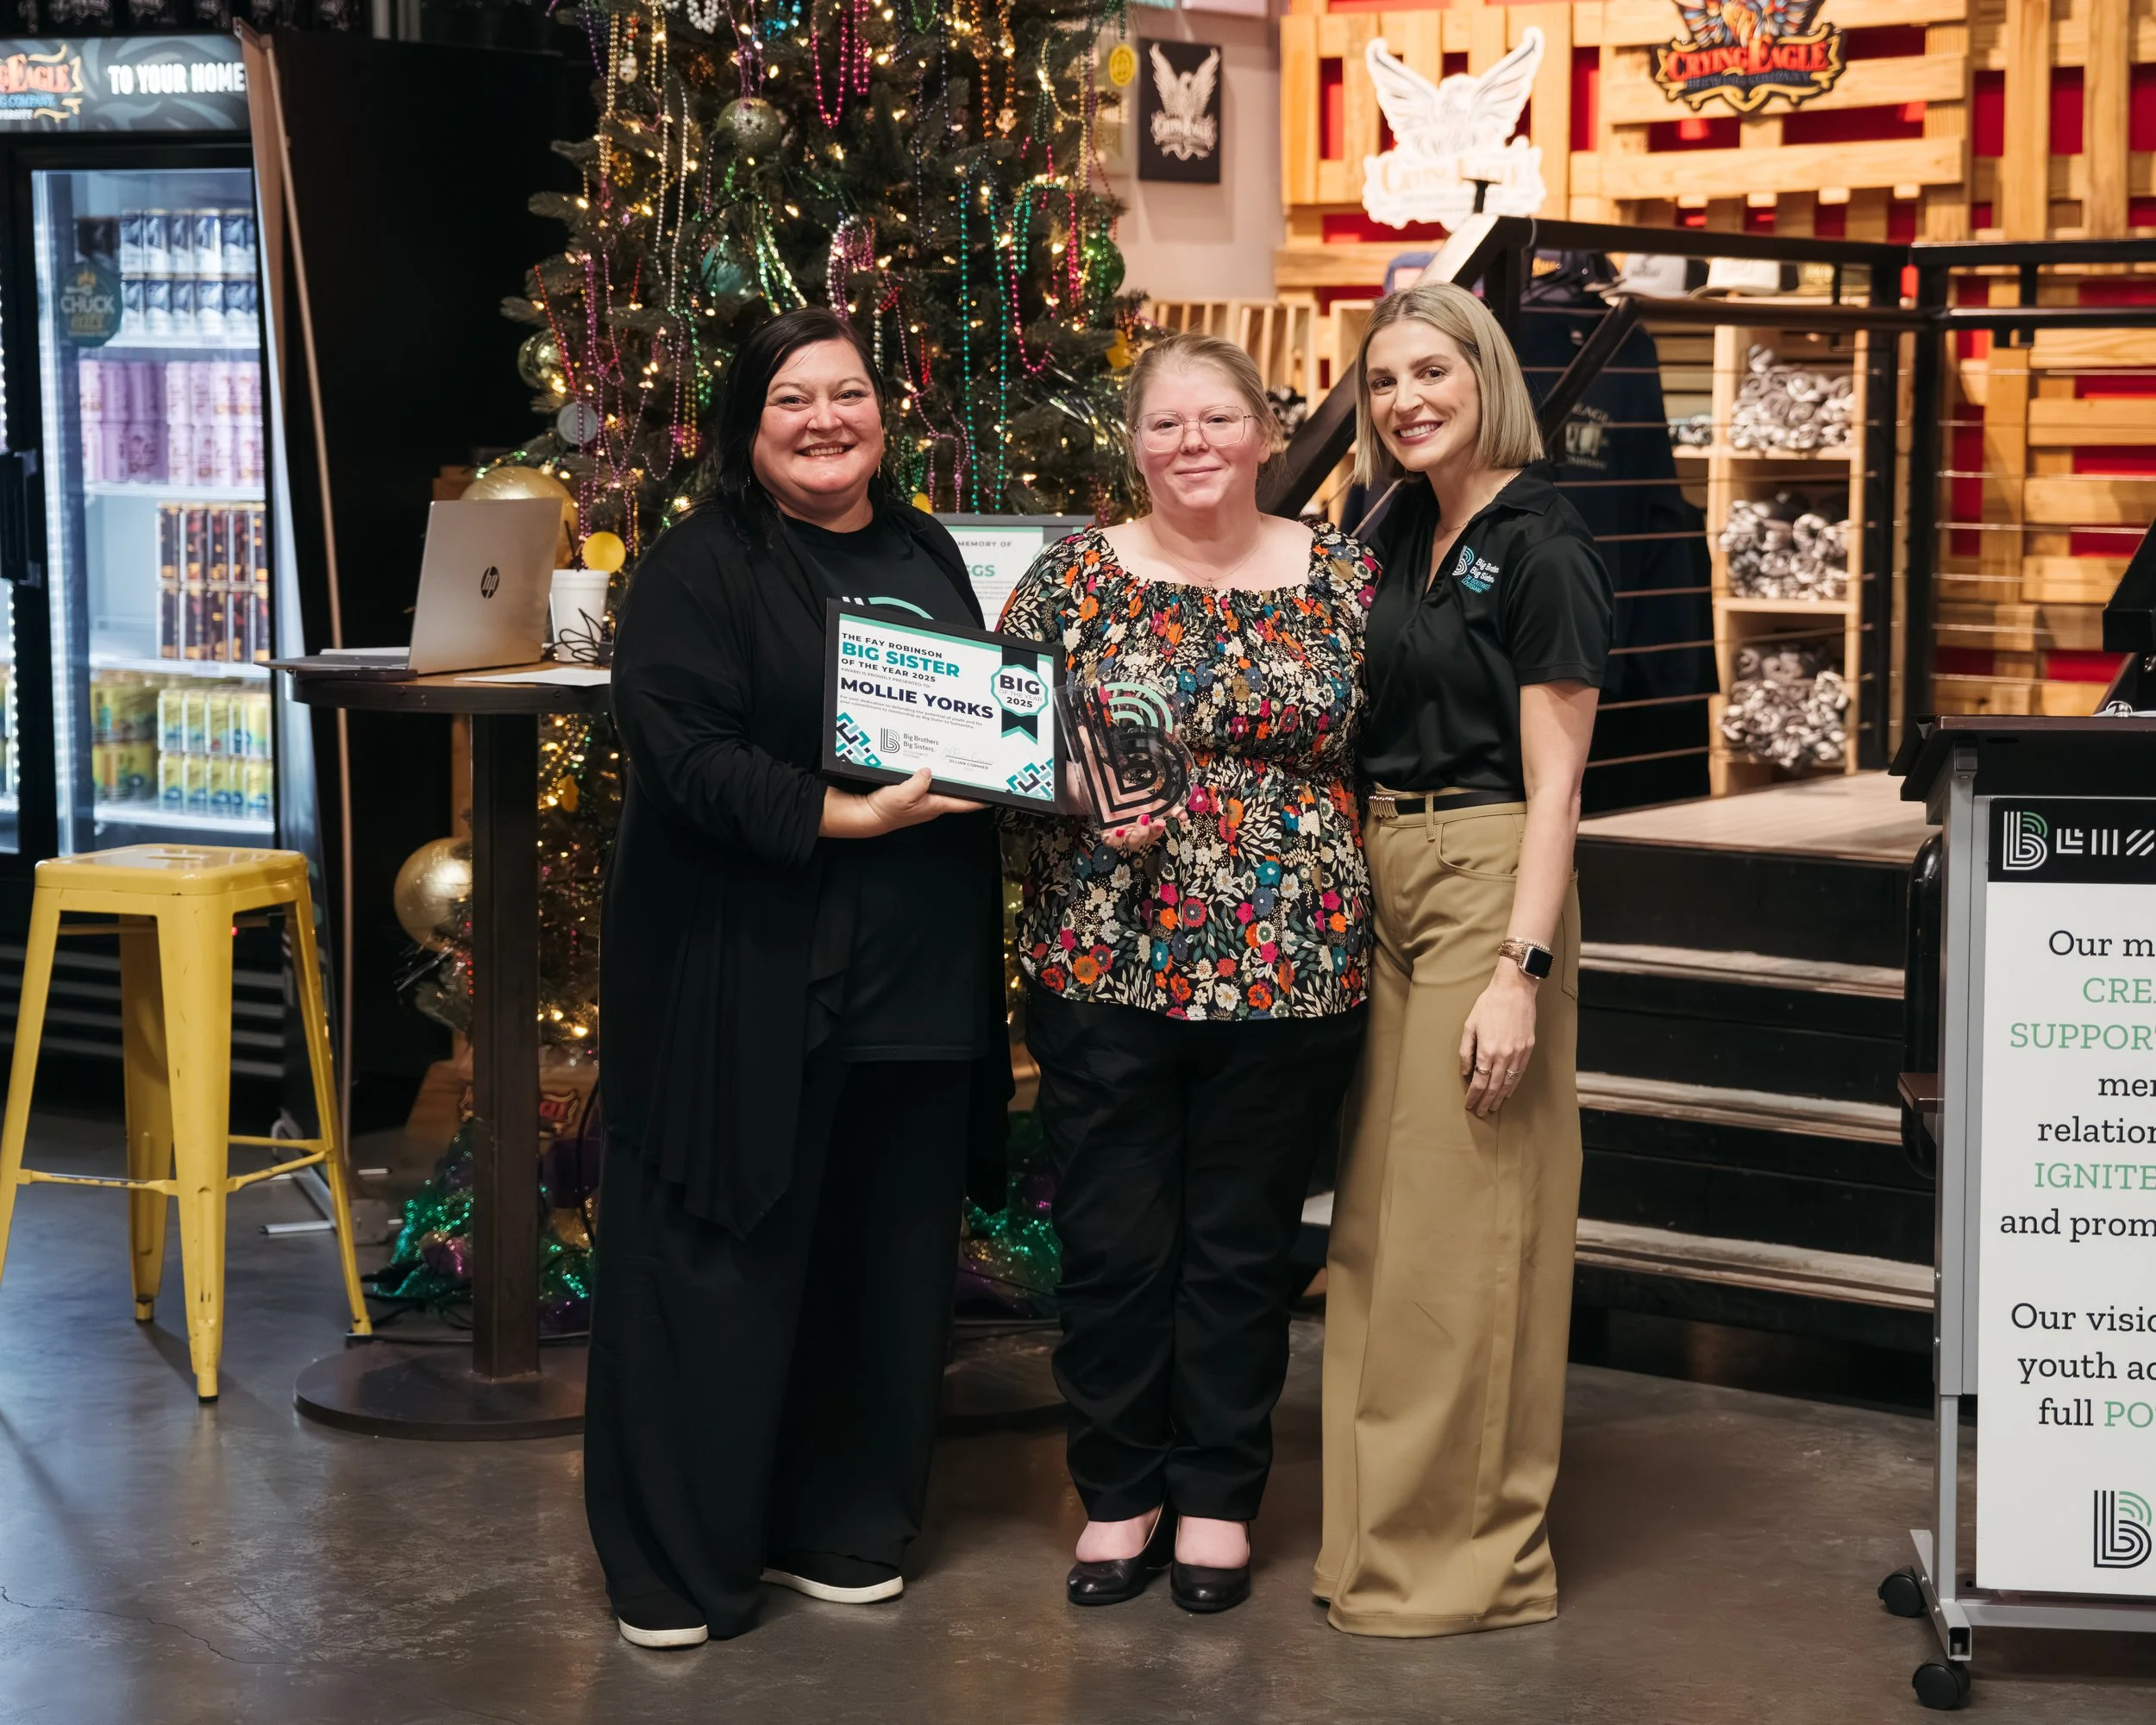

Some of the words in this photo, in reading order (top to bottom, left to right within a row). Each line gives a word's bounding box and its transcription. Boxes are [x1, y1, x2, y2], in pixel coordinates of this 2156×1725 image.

[107, 65, 134, 95] TO
[135, 63, 188, 94] YOUR
[191, 62, 246, 92] HOME
[1470, 566, 1482, 579] Big
[1476, 558, 1486, 570] Big
[842, 633, 862, 643] THE
[865, 637, 885, 647] FAY
[888, 643, 943, 659] ROBINSON
[842, 642, 880, 661] BIG
[886, 651, 960, 678] SISTER
[858, 662, 878, 671] THE
[881, 666, 909, 677] YEAR
[912, 672, 937, 683] 2025
[867, 673, 892, 681] PROUDLY
[892, 677, 922, 687] PRESENTED
[1000, 674, 1039, 694] BIG
[840, 677, 918, 705] MOLLIE
[923, 693, 993, 719] YORKS
[1006, 697, 1032, 707] 2025
[903, 733, 913, 742] Big
[914, 735, 939, 745] Brothers
[903, 741, 913, 750] Big
[2048, 930, 2113, 957] Our
[2122, 938, 2156, 957] m
[2083, 977, 2156, 1004] CRE
[2010, 1022, 2156, 1051] SUPPOR
[2034, 1163, 2156, 1190] IGNITE
[2000, 1208, 2061, 1234] and
[2070, 1217, 2156, 1243] prom
[2011, 1302, 2077, 1330] Our
[2017, 1352, 2117, 1384] youth
[2039, 1396, 2094, 1427] full
[2104, 1401, 2156, 1428] PO
